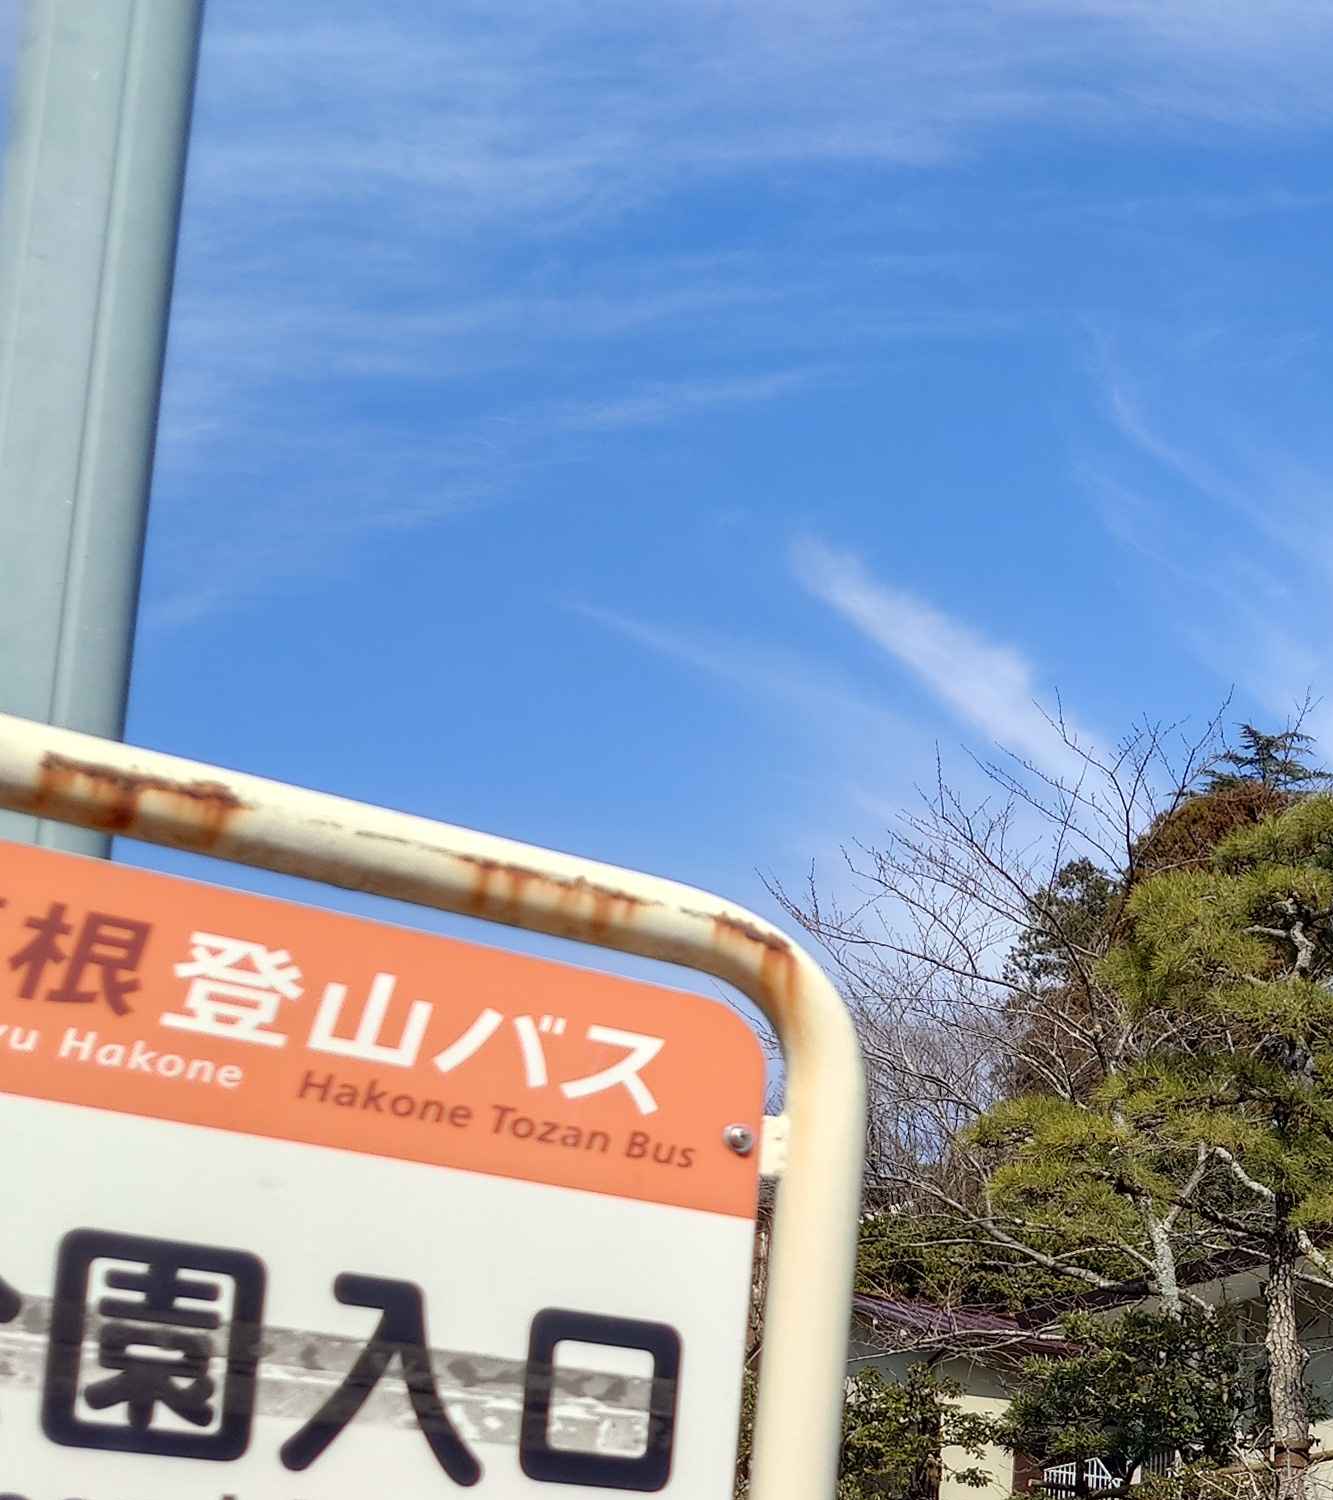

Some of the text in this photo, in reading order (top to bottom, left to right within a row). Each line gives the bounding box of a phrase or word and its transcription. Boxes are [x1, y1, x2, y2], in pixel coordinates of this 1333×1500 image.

[0, 897, 666, 1116] 根登山バス
[56, 1026, 243, 1088] Hakone
[297, 1069, 696, 1168] Hakone Tozan Bus
[0, 1226, 683, 1493] 園入口
